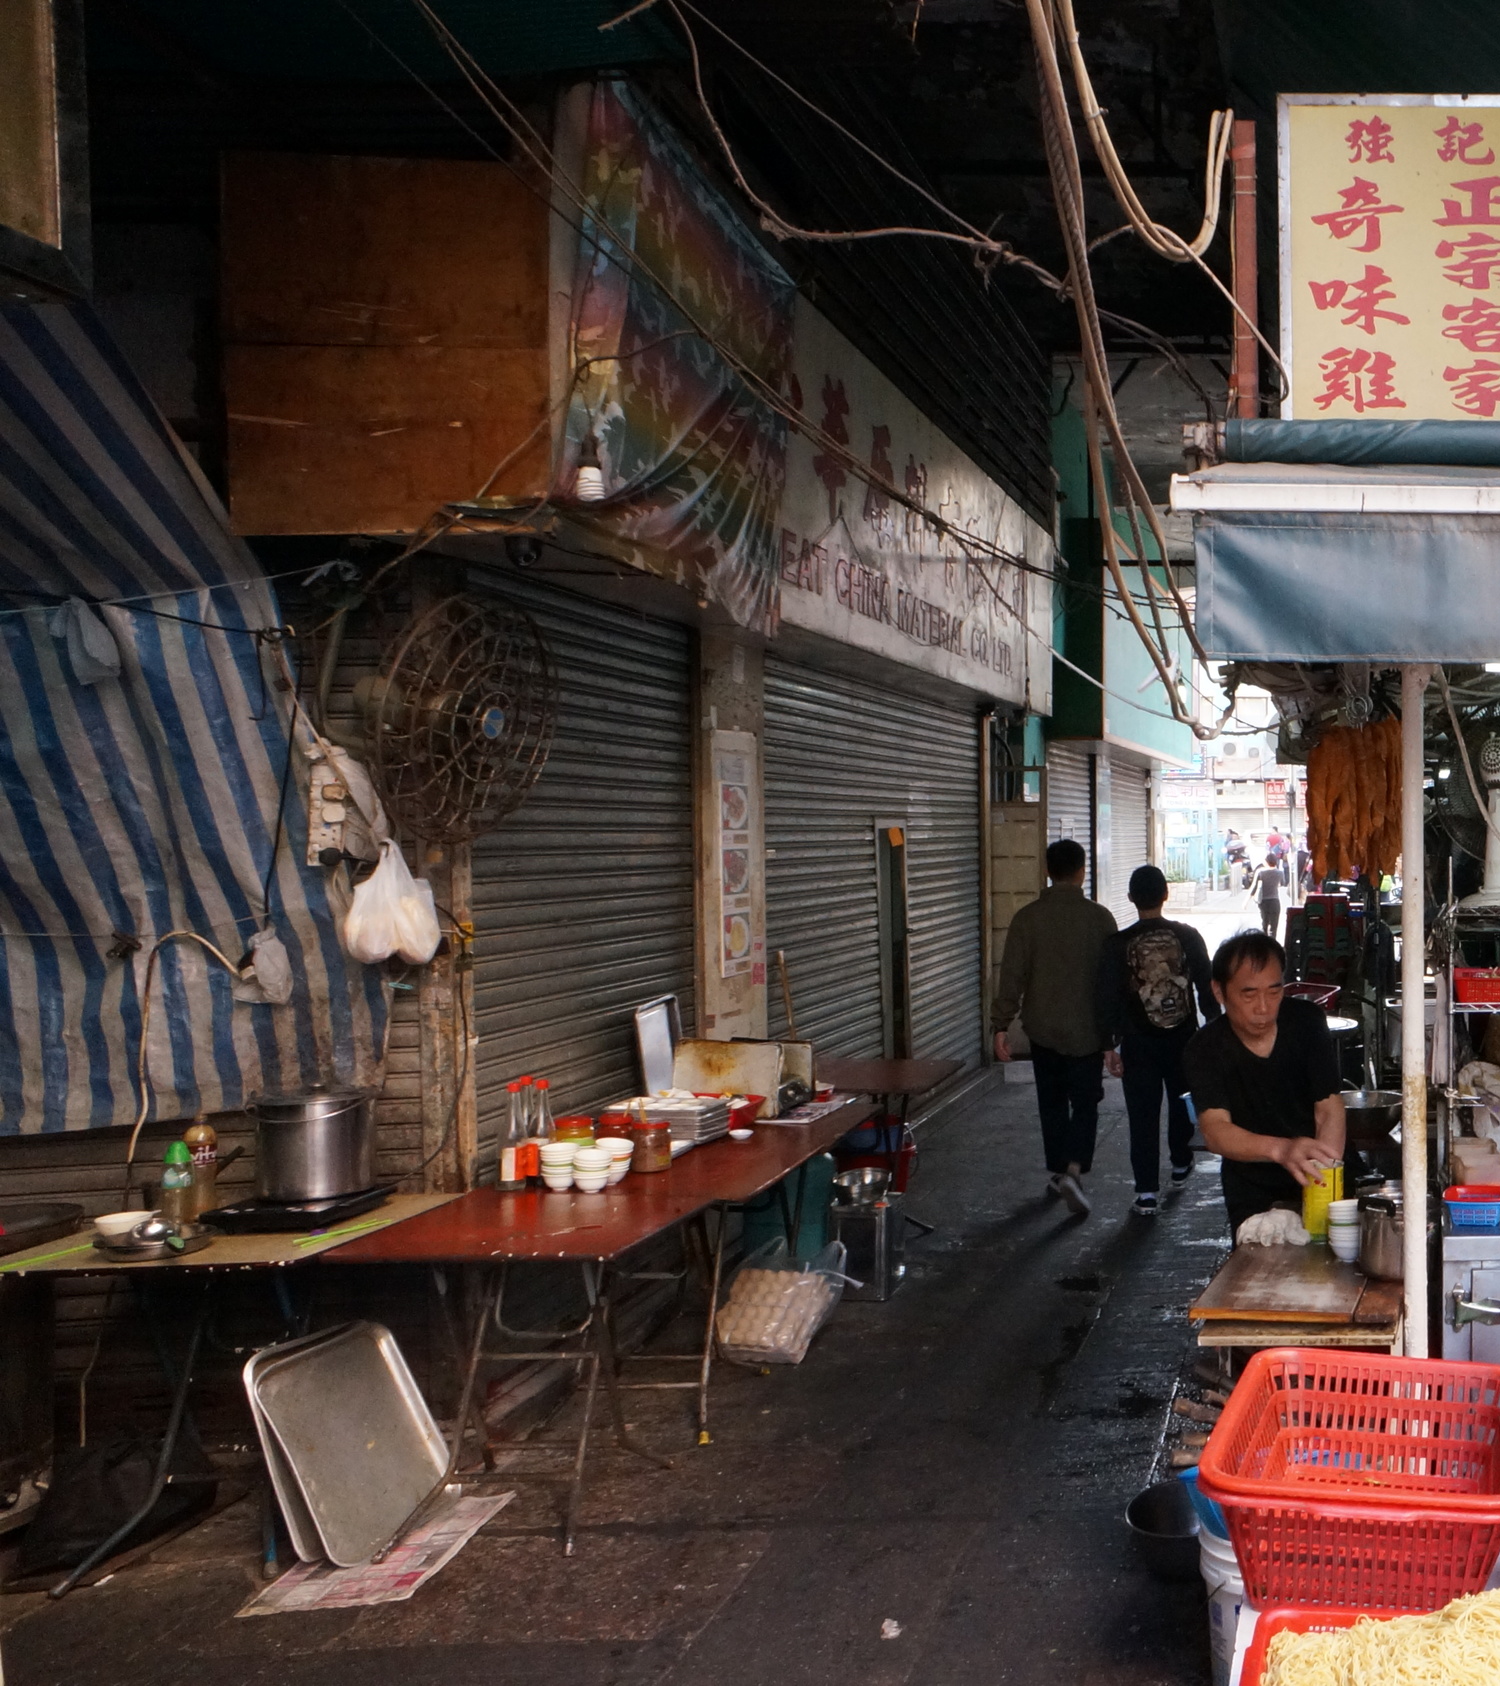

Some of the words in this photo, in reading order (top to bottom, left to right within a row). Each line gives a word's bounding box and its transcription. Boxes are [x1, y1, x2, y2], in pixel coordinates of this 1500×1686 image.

[1308, 176, 1411, 413] 奇味雞
[835, 558, 892, 626] CHINA
[897, 587, 967, 659] MATERIAL
